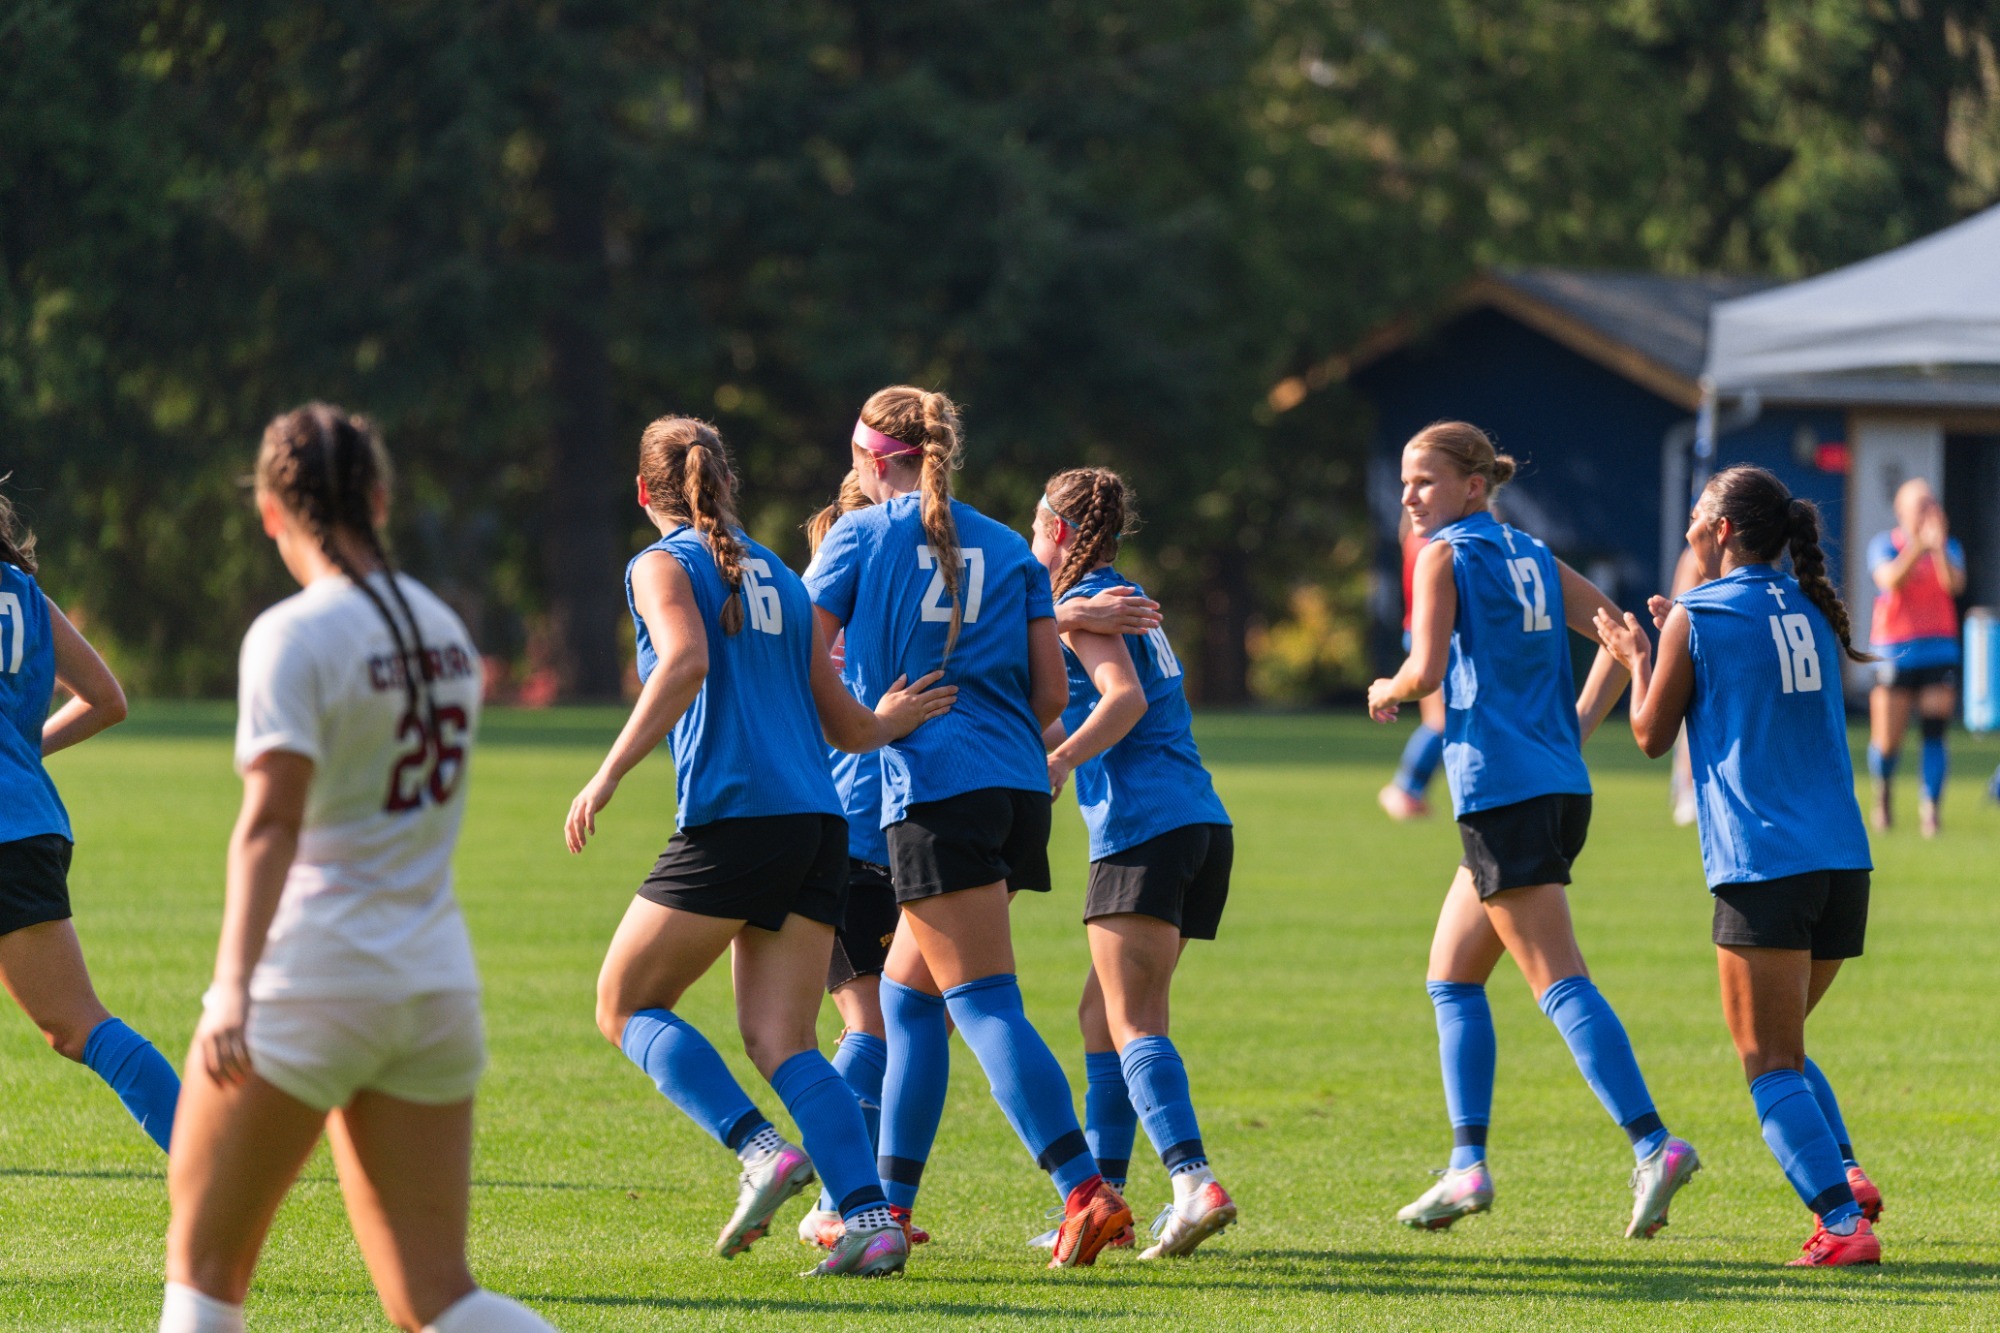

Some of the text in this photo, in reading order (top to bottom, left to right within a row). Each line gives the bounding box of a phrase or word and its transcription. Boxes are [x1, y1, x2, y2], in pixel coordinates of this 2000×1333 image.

[740, 557, 782, 633] 16
[916, 544, 985, 624] 27
[1506, 556, 1552, 632] 12
[0, 591, 24, 674] 7
[1768, 613, 1822, 694] 18
[383, 704, 468, 812] 26
